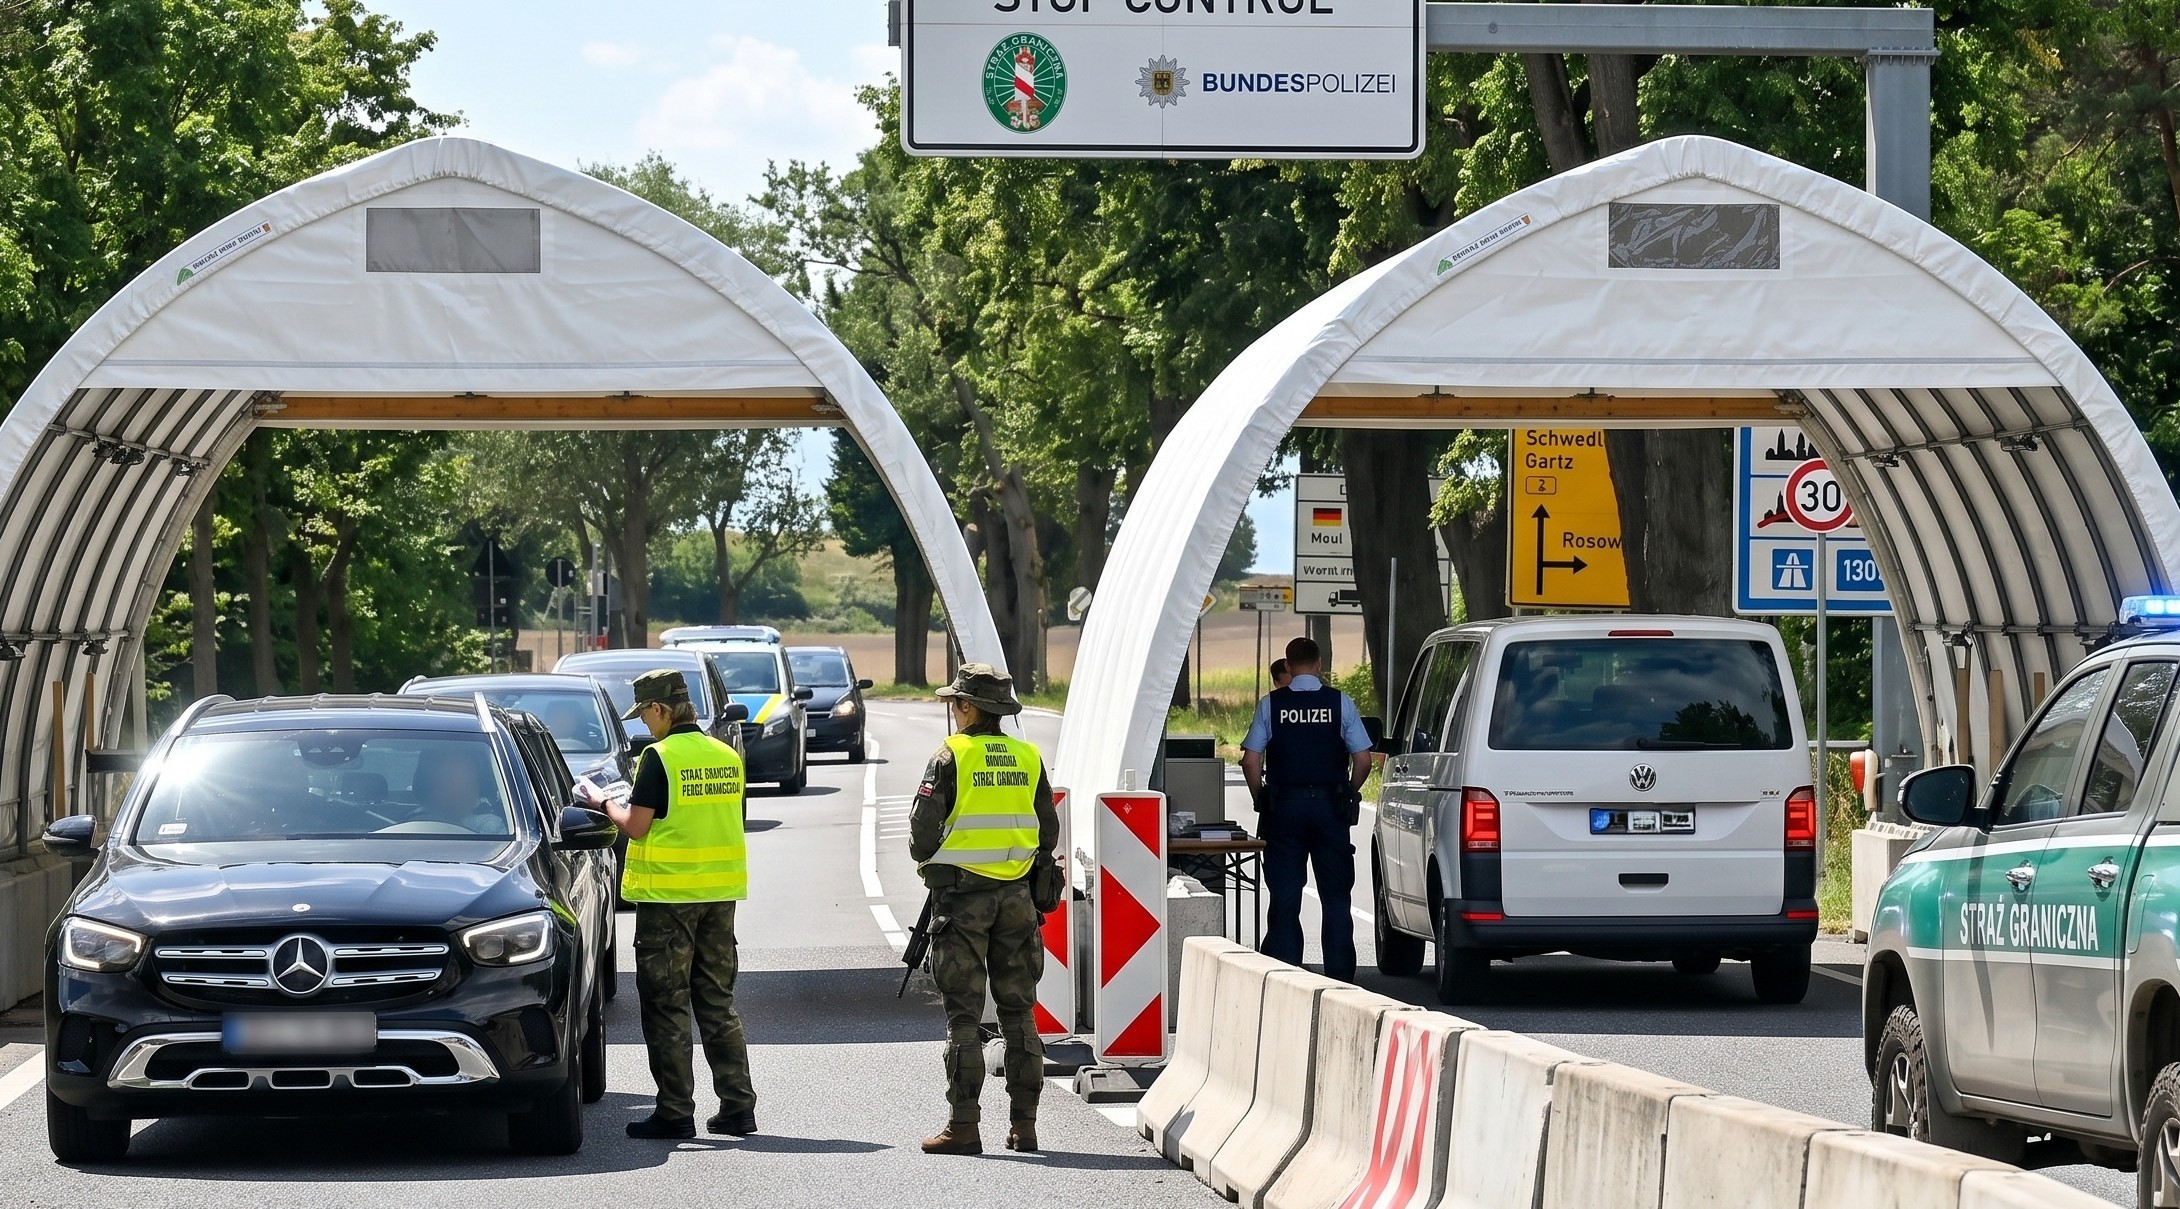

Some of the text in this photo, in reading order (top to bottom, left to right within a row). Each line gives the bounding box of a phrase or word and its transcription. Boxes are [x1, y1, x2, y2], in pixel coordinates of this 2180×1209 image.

[1203, 73, 1396, 93] BUNDESPOLIZEI
[1525, 453, 1574, 469] Gartz
[1800, 480, 1841, 512] 30
[1280, 708, 1332, 724] POLIZEI
[1960, 894, 2099, 951] STRAŻ GRANICZNA
